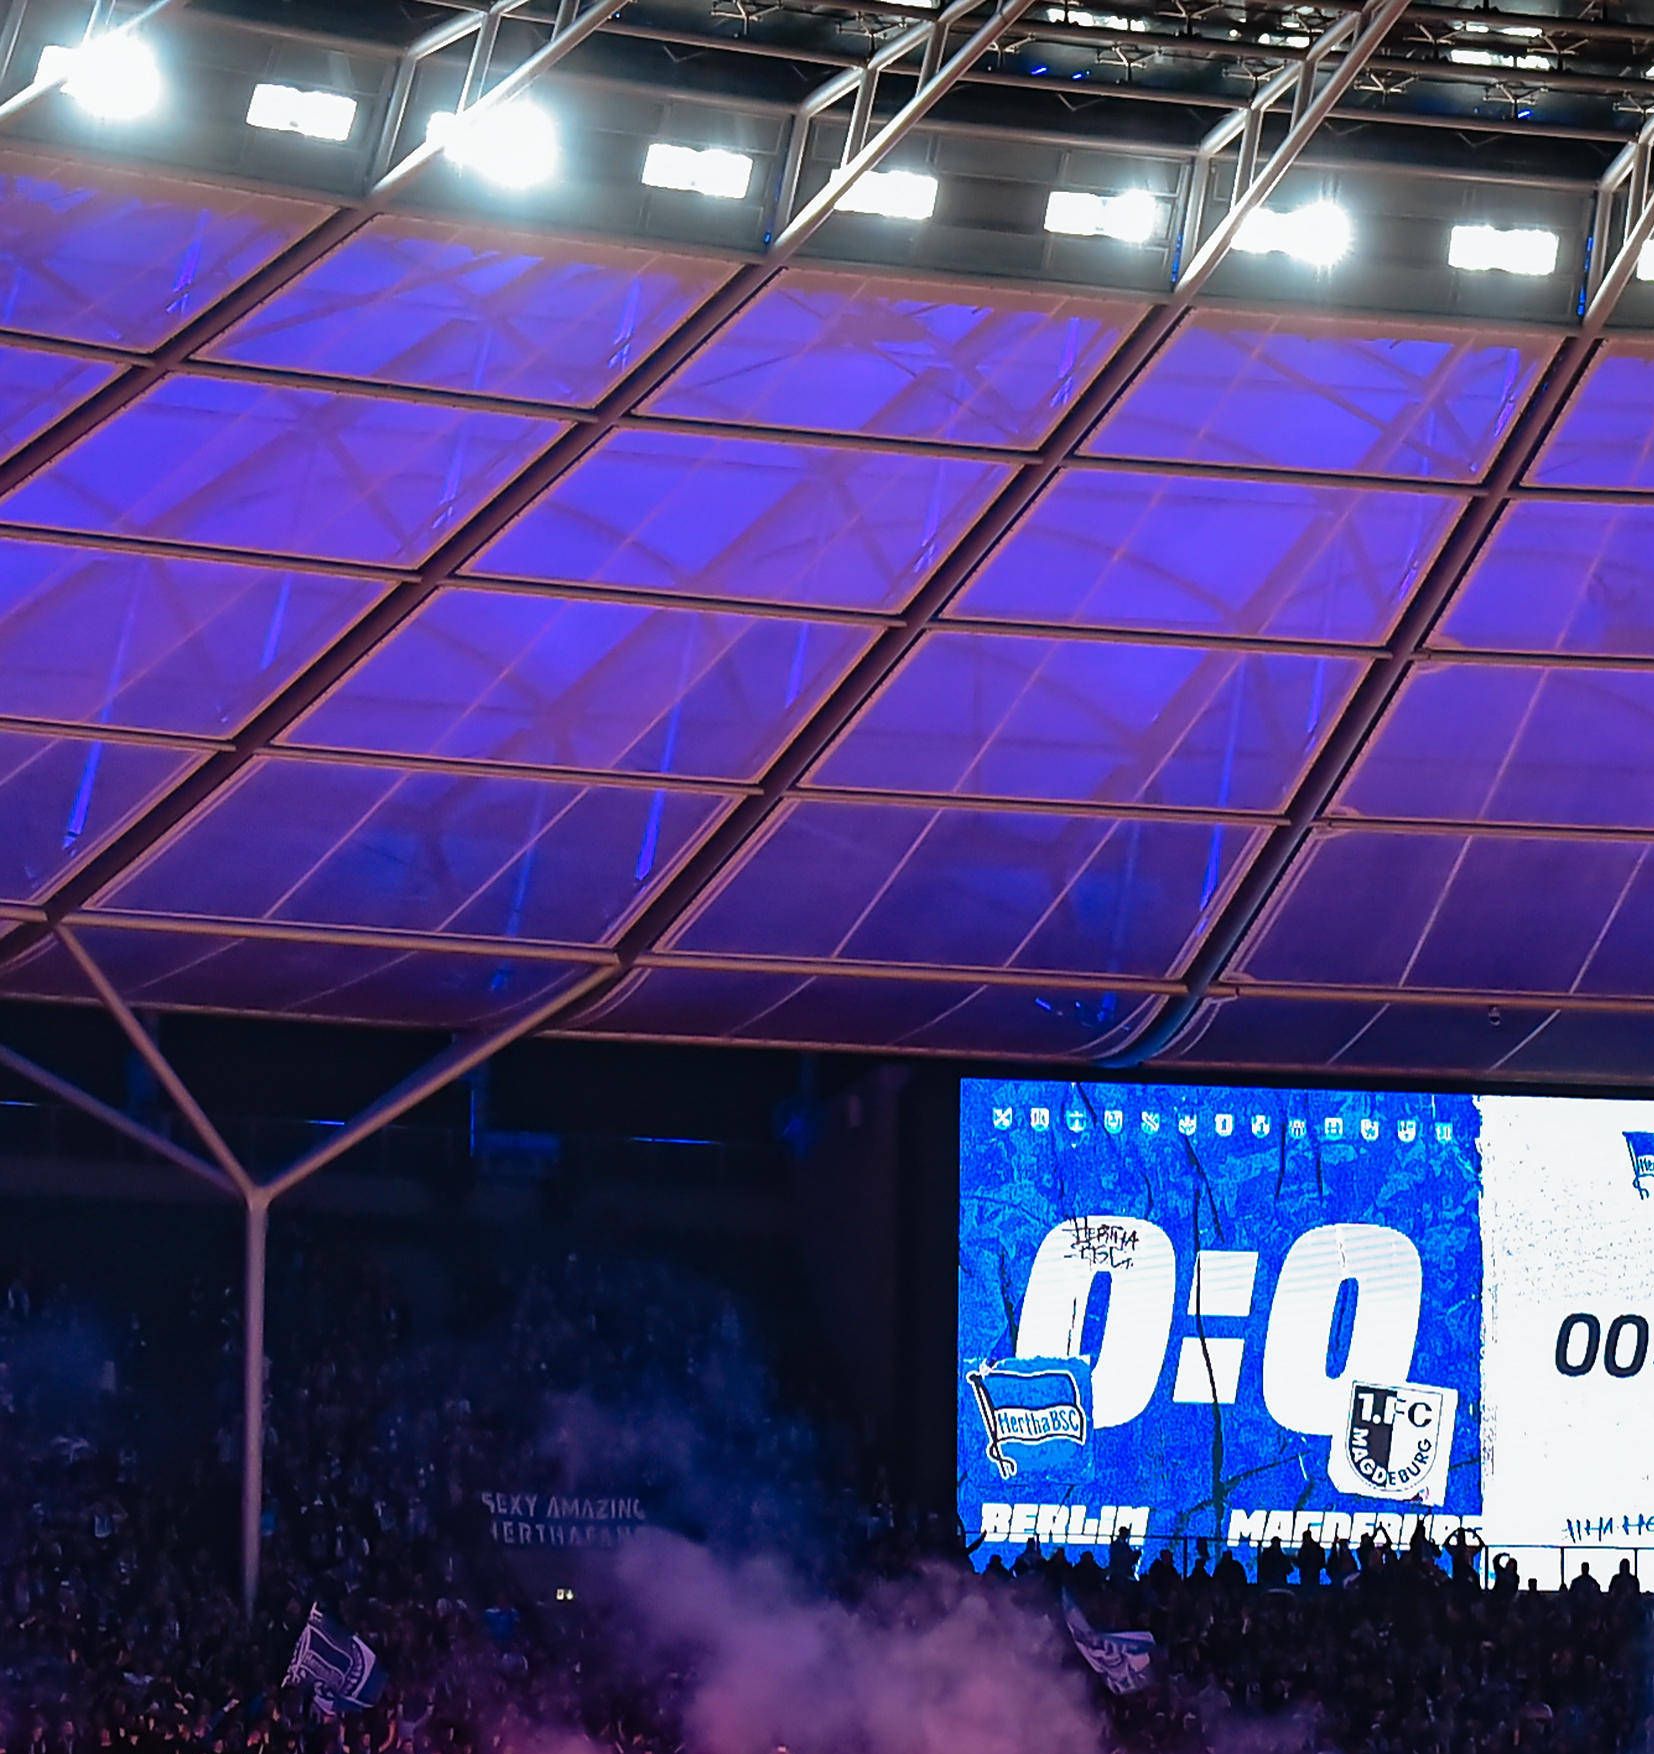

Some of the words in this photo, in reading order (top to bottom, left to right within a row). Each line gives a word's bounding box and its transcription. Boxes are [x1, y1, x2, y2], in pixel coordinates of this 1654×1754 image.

[1351, 1427, 1432, 1487] MAGDEBURG
[481, 1491, 539, 1517] SEXY
[546, 1496, 647, 1520] AMAZING
